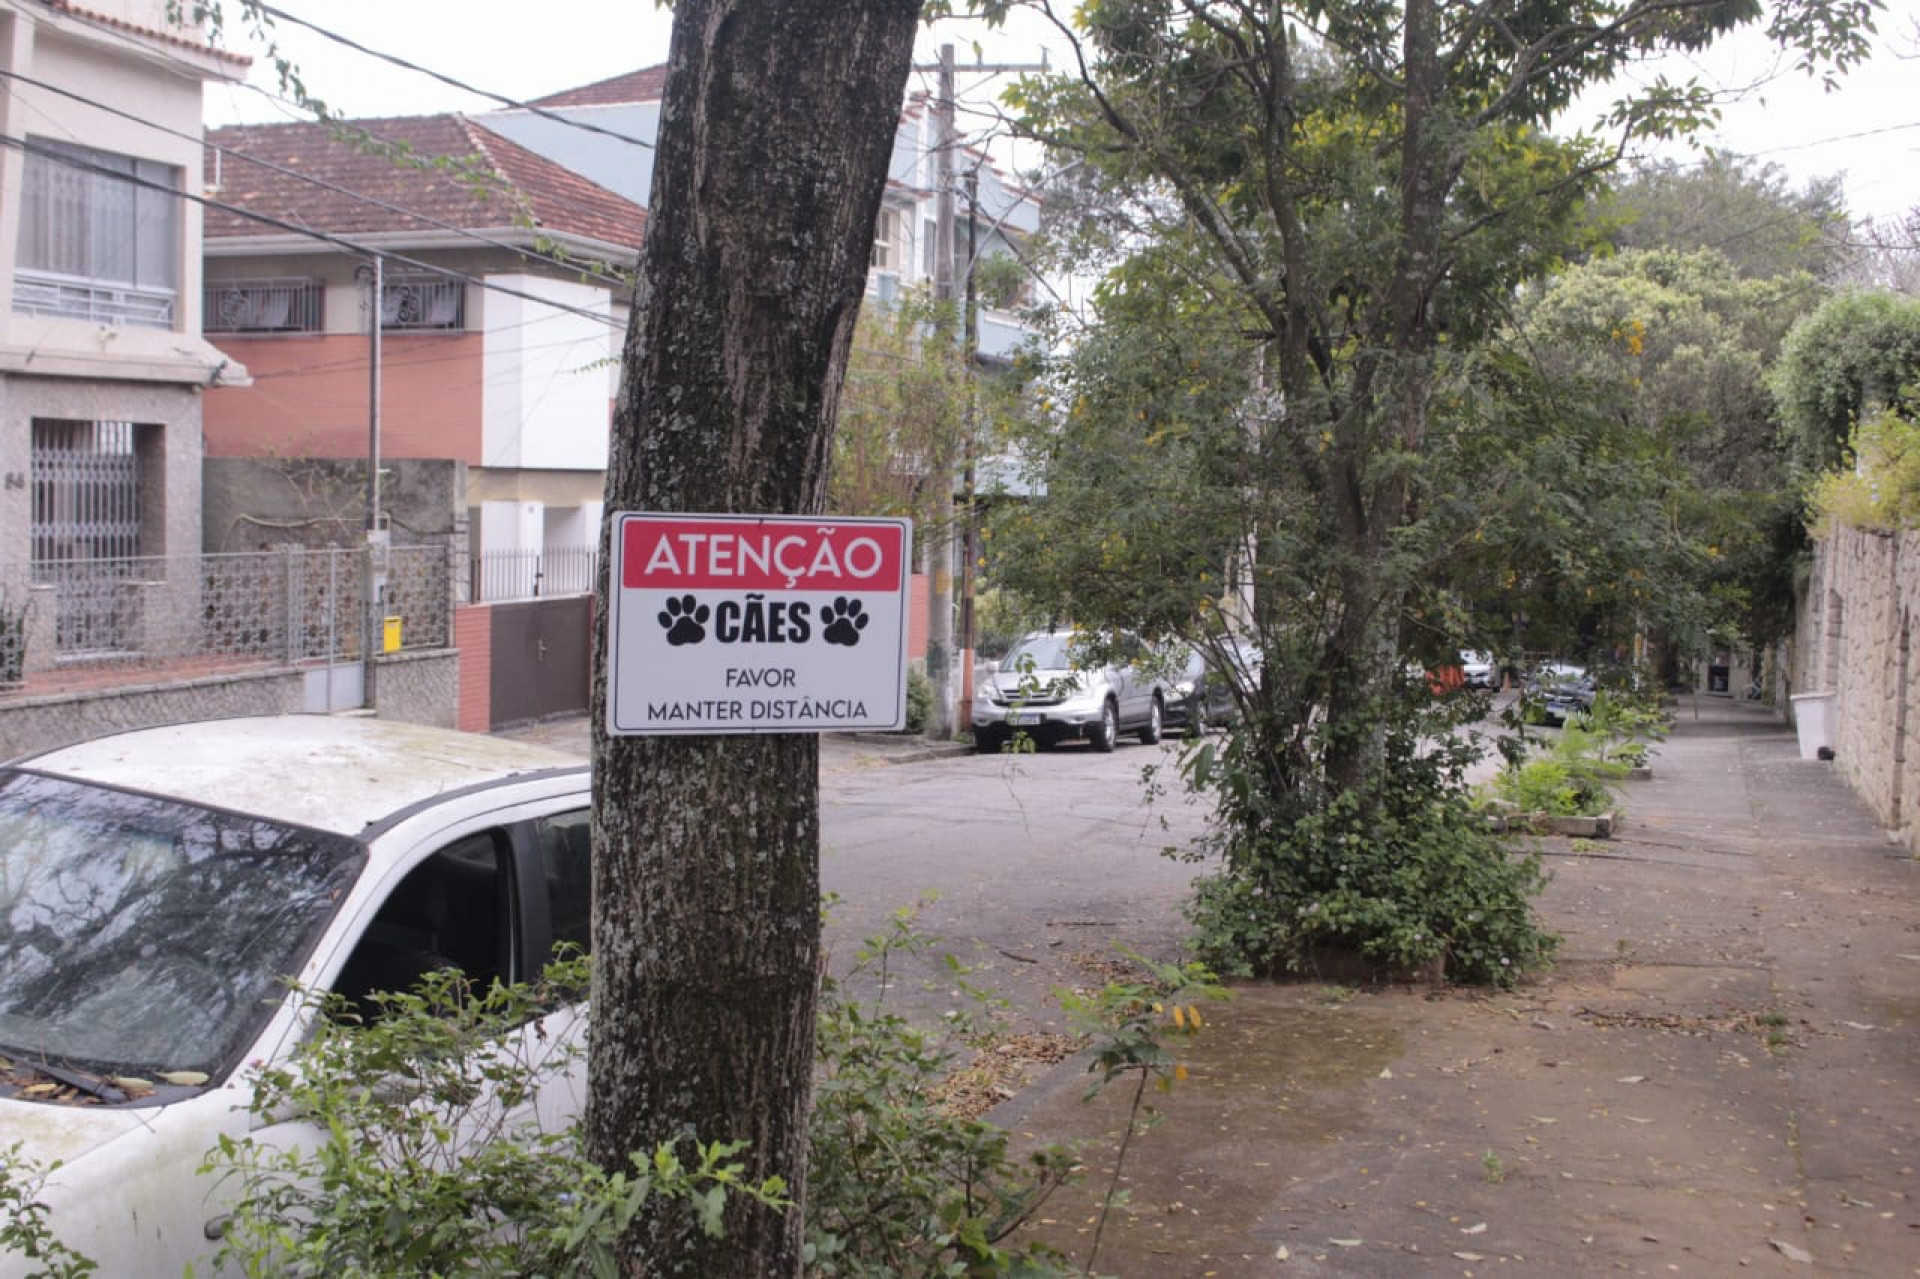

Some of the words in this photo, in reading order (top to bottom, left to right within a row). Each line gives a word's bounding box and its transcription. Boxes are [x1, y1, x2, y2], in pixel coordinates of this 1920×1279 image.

[644, 527, 883, 588] ATENÇÃO
[714, 592, 811, 643] CÃES
[725, 668, 796, 688] FAVOR
[647, 701, 743, 720] MANTER
[751, 696, 868, 719] DISTÂNCIA
